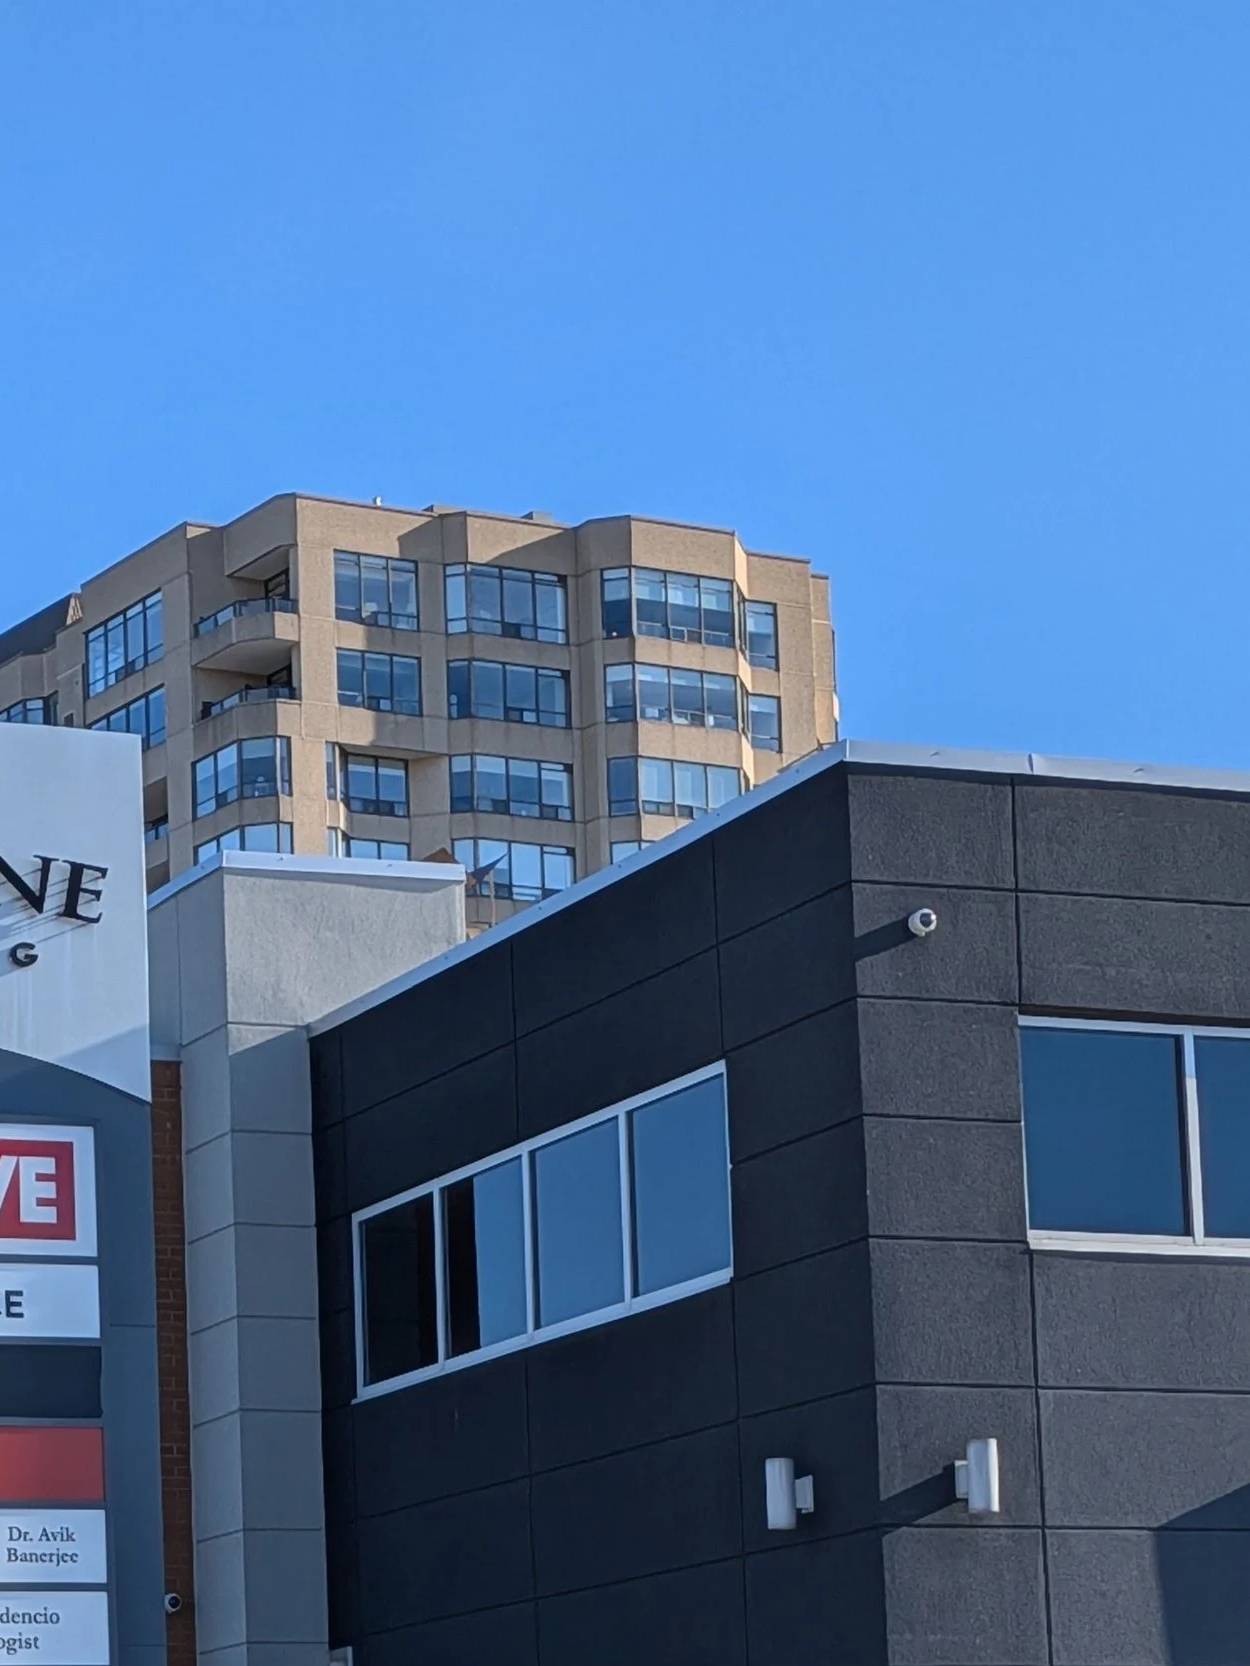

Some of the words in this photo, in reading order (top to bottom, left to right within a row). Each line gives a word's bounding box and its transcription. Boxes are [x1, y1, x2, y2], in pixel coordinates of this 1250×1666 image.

[7, 1526, 34, 1543] Dr.
[37, 1526, 76, 1543] Avik
[6, 1548, 79, 1567] Banerjee
